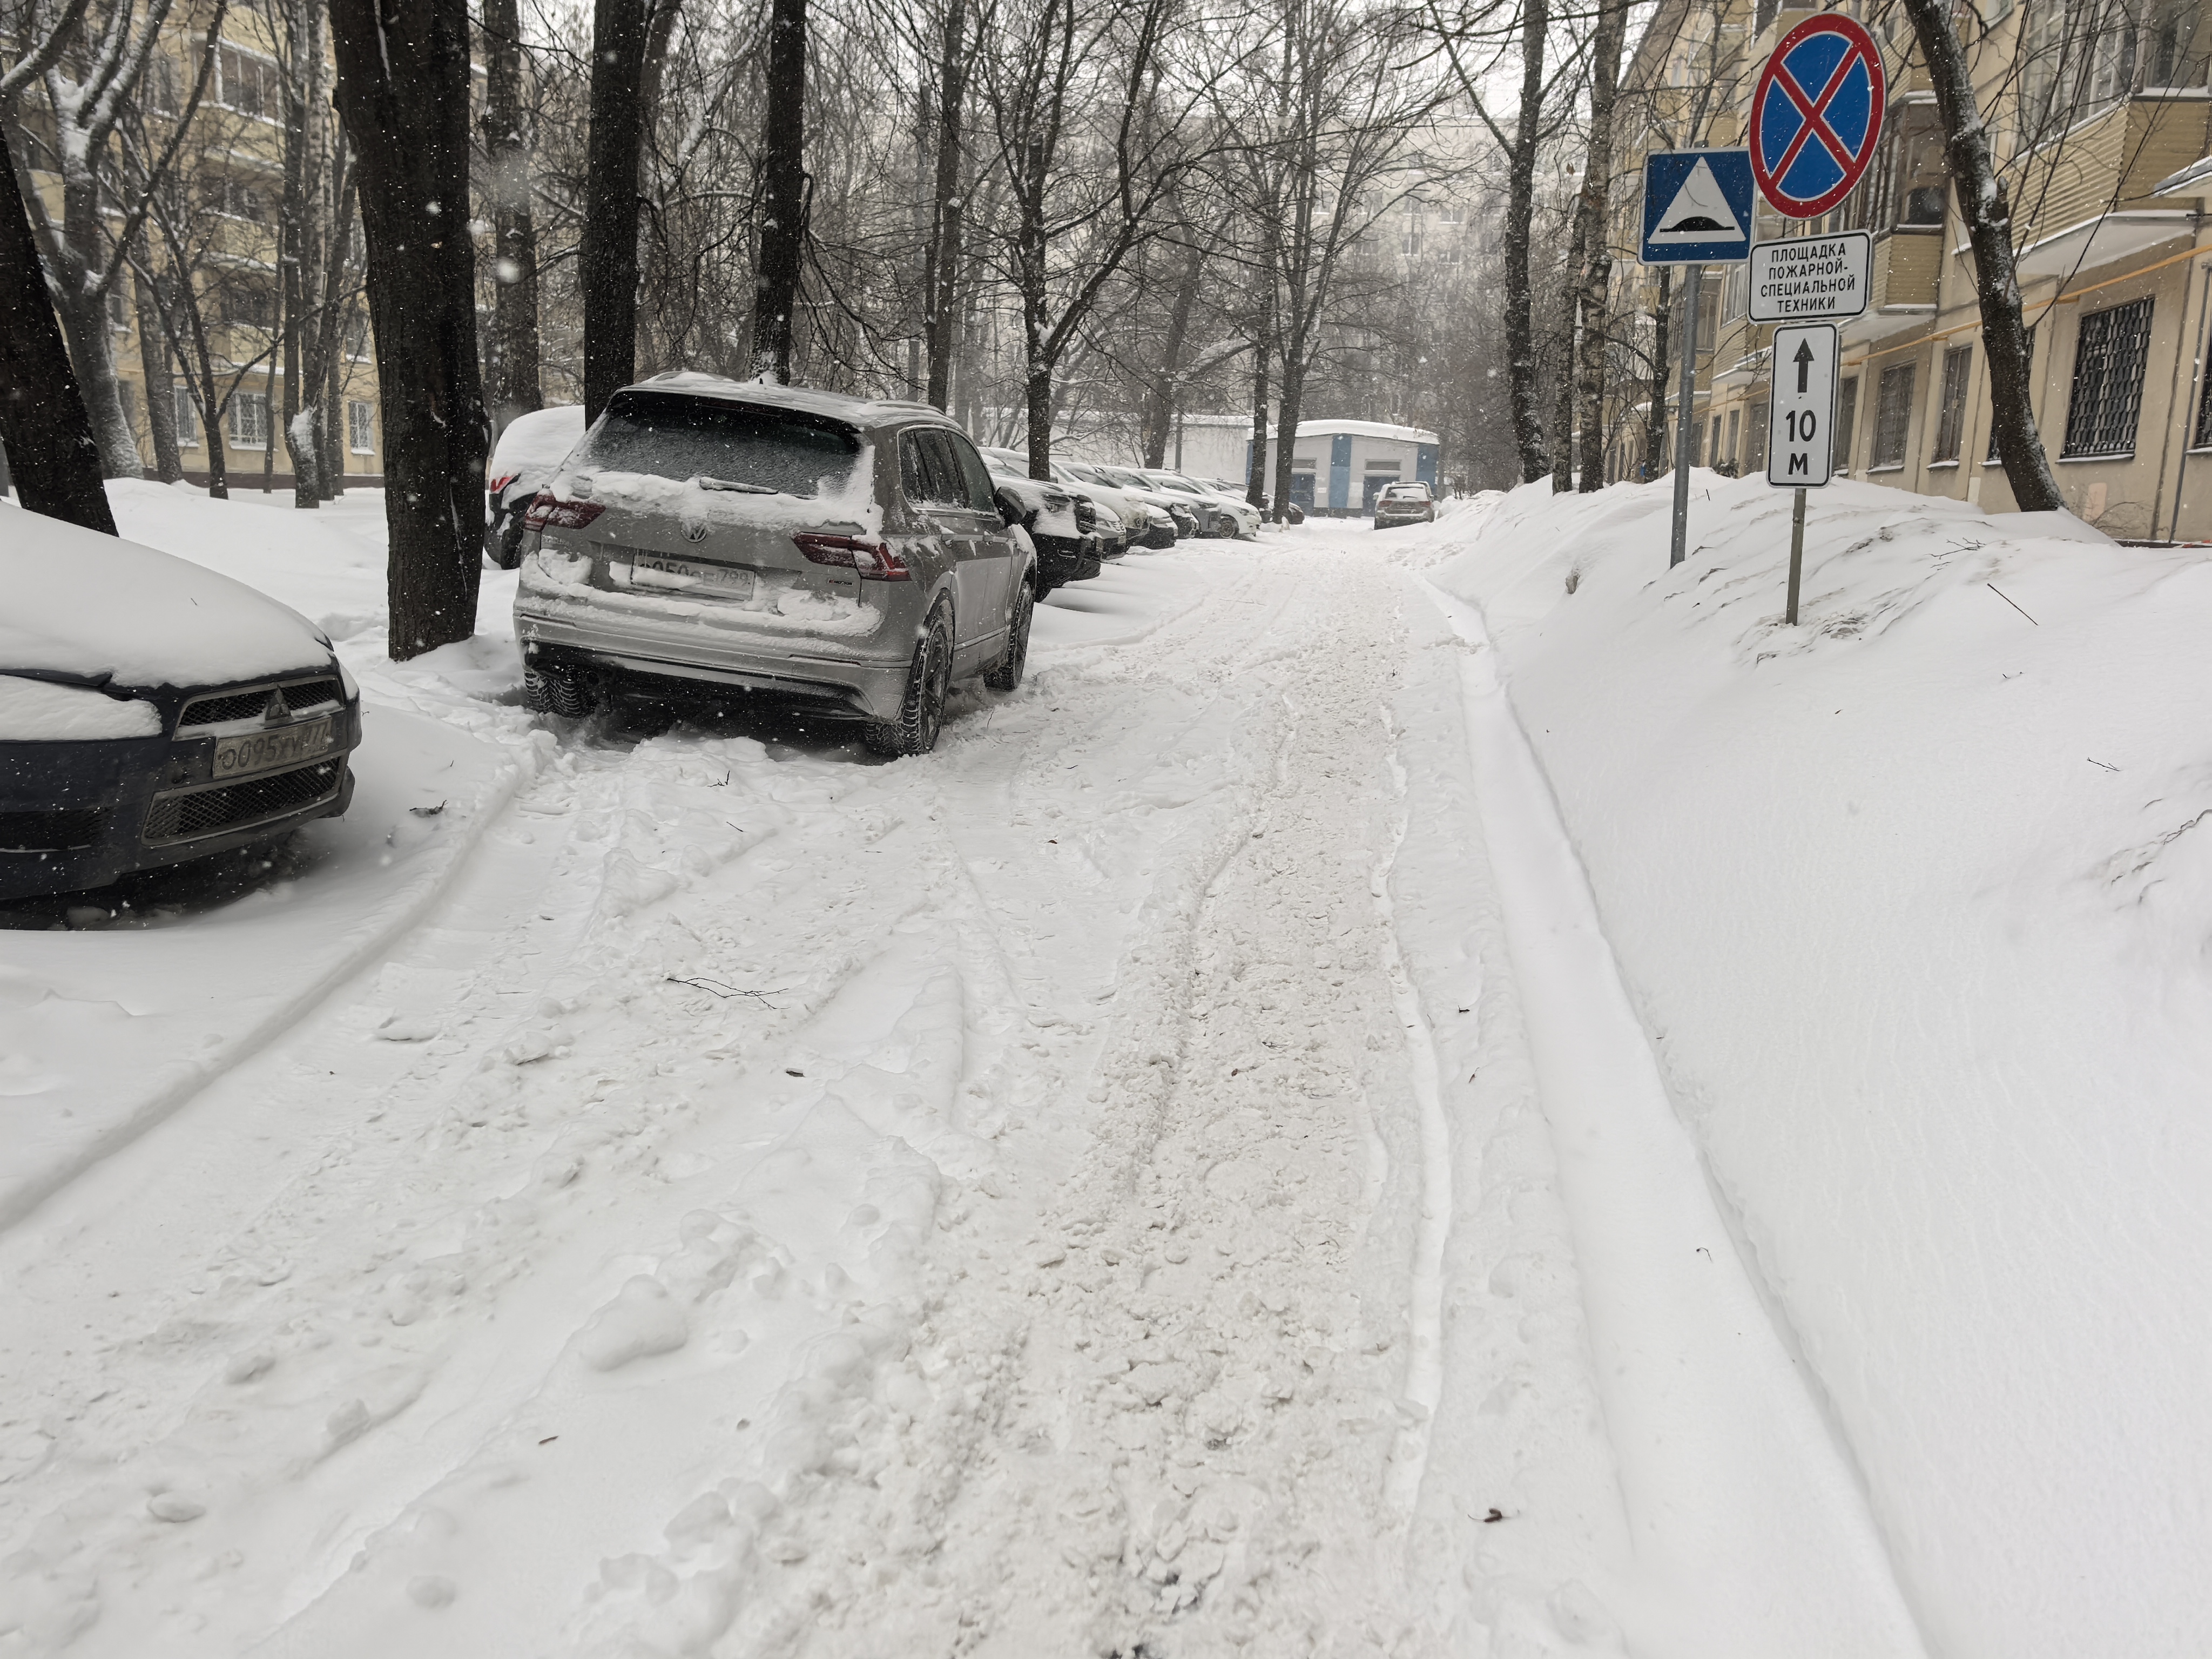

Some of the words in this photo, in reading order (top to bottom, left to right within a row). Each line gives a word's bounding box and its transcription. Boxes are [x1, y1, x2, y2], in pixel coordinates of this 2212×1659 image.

[1771, 242, 1846, 263] ПЛОЩАДКА
[1768, 257, 1848, 280] ПОЖАРНОЙ-
[1761, 274, 1856, 297] СПЕЦИАЛЬНОЙ
[1777, 296, 1836, 313] ТЕХНИКИ
[1785, 409, 1816, 442] 10
[1788, 453, 1808, 475] М
